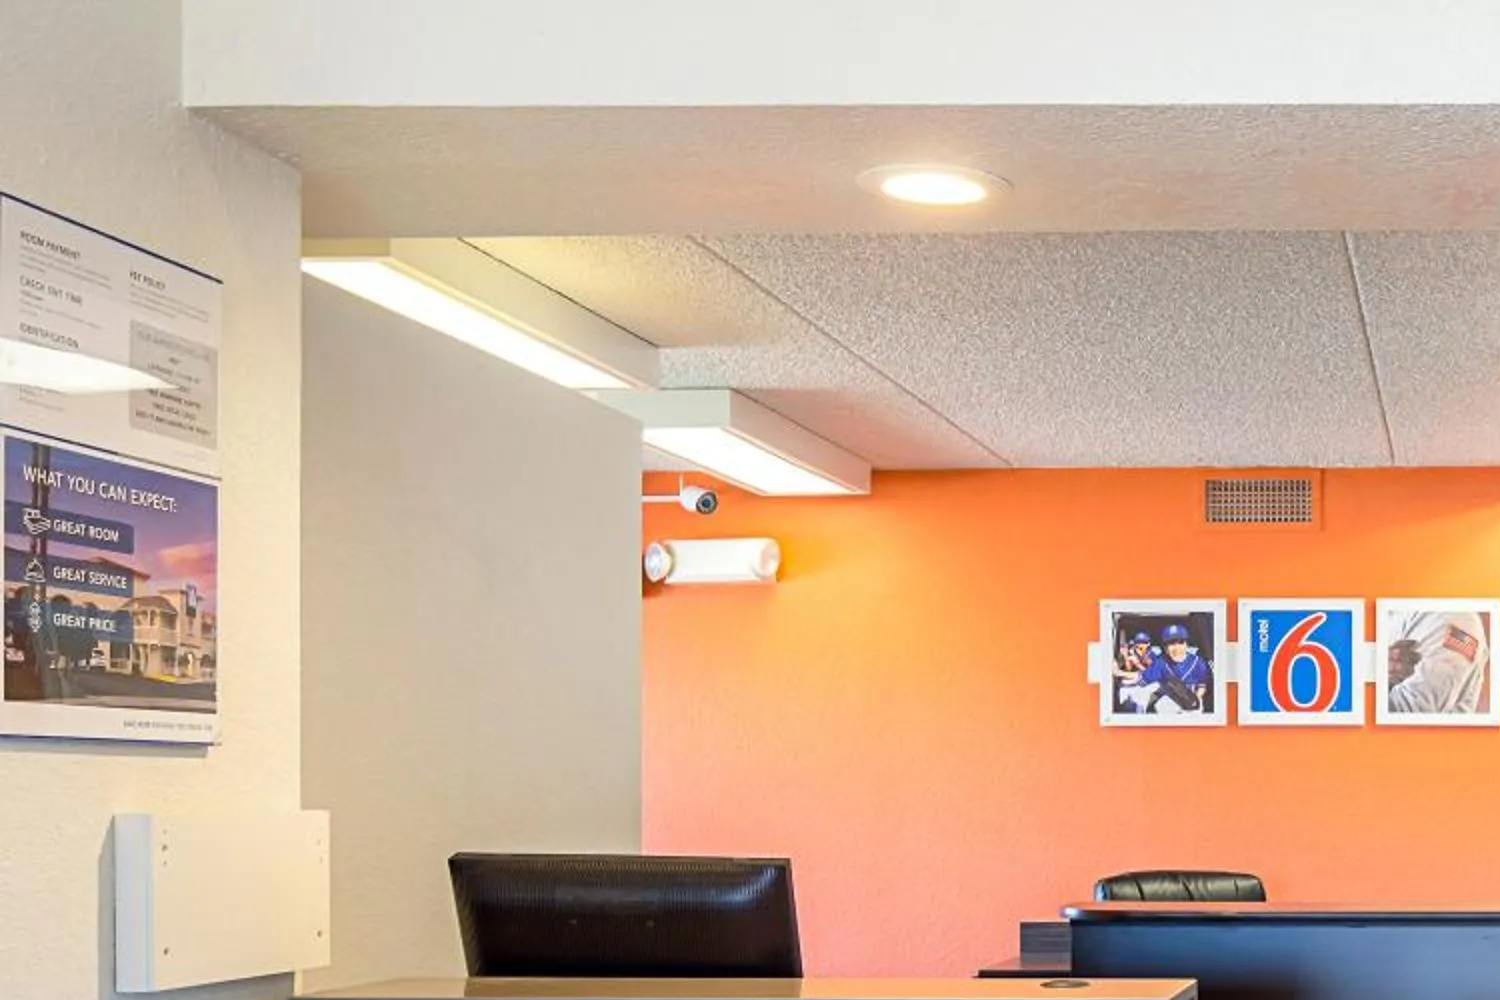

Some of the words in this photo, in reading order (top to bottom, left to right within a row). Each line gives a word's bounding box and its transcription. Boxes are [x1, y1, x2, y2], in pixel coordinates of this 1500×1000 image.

[20, 231, 45, 247] ROOM
[23, 465, 64, 489] WHAT
[67, 474, 96, 496] YOU
[99, 482, 127, 503] CAN
[131, 488, 178, 513] EXPECT:
[53, 519, 85, 537] GREAT
[88, 525, 120, 542] ROOM
[53, 566, 86, 583] GREAT
[88, 571, 128, 589] SERVICE
[53, 612, 86, 629] GREAT
[88, 616, 117, 633] PRICE
[1257, 619, 1269, 653] motel
[1267, 612, 1341, 712] 6
